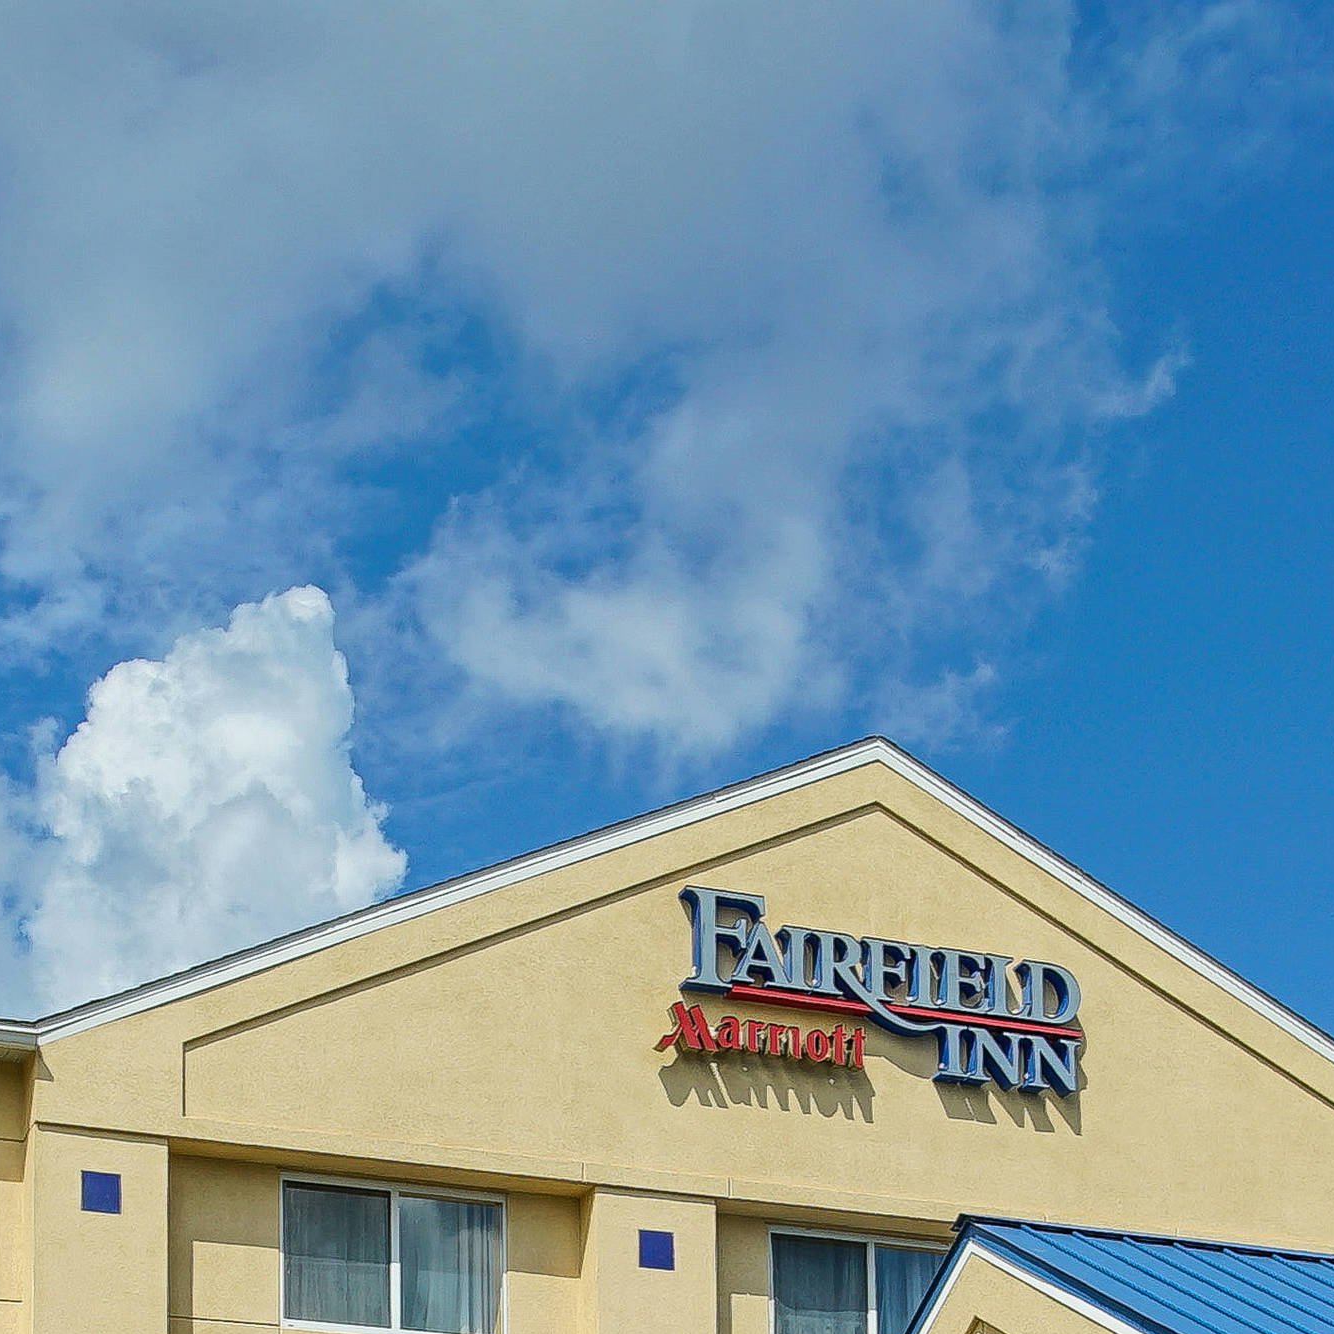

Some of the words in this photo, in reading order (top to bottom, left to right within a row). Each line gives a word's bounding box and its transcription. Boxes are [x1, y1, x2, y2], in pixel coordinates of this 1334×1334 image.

[679, 885, 1084, 1031] FAIRFIELD
[653, 1001, 867, 1069] Marriott
[931, 1023, 1083, 1098] INN
